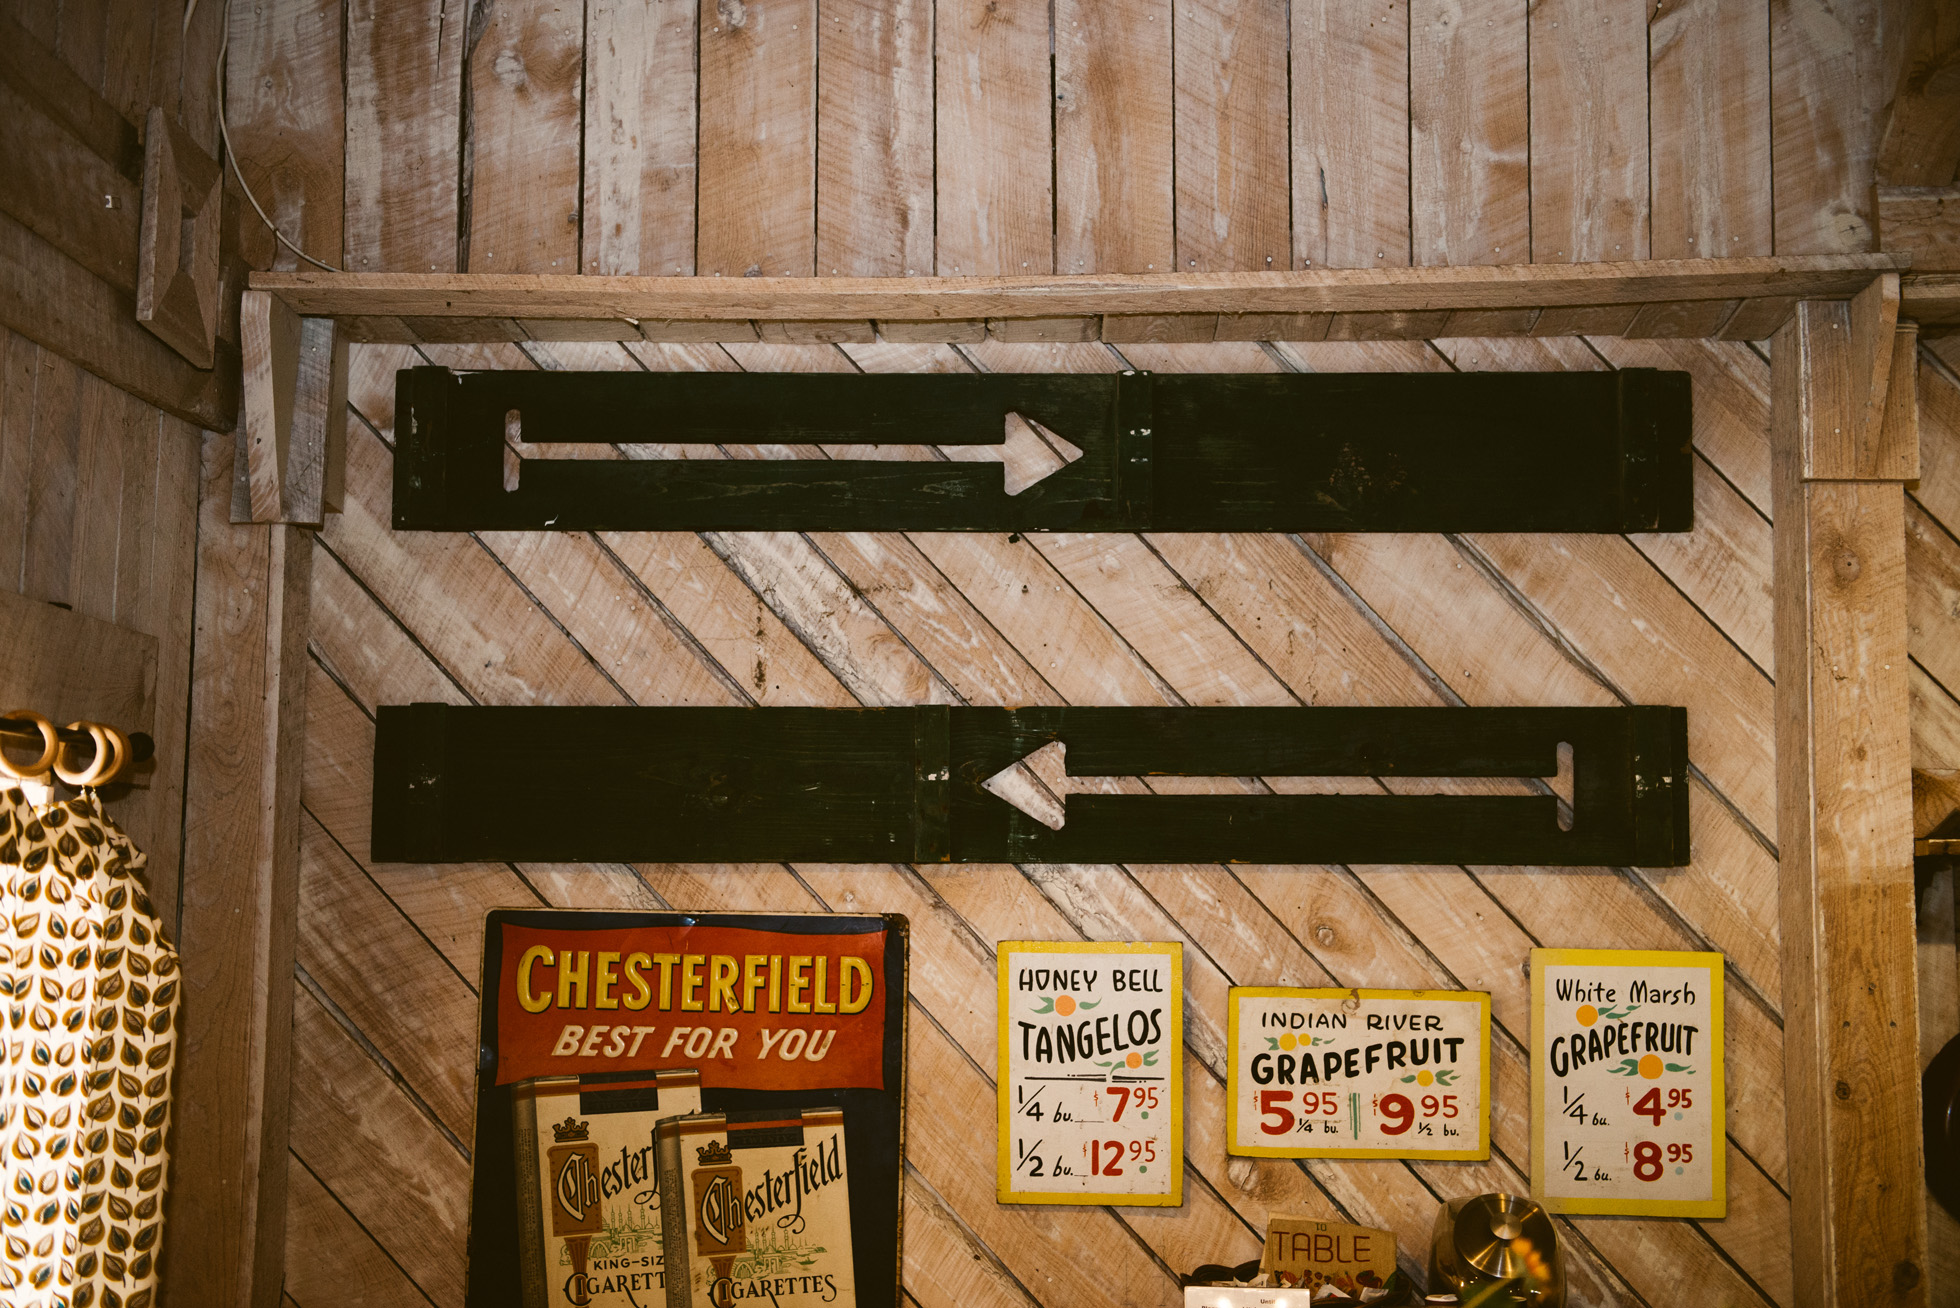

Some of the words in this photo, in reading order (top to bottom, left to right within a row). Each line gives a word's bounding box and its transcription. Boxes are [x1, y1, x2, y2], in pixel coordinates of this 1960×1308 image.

[516, 945, 874, 1014] CHESTERFIELD
[1019, 969, 1097, 992] HONEY
[1112, 969, 1163, 992] BELL
[1556, 978, 1616, 1002] White
[1630, 980, 1696, 1006] Marsh
[1018, 1008, 1162, 1063] TANGELOS
[1262, 1013, 1346, 1029] INDIAN
[1367, 1014, 1443, 1031] RIVER
[551, 1025, 656, 1058] BEST
[660, 1026, 739, 1060] FOR
[757, 1028, 836, 1061] YOU
[1251, 1037, 1464, 1085] GRAPEFRUIT
[1551, 1022, 1698, 1077] GRAPEFRUIT
[557, 1127, 661, 1222] Chesterf
[701, 1133, 843, 1245] Chesterfield
[1315, 1223, 1327, 1231] TO
[594, 1255, 664, 1271] KING-SIZ
[1272, 1231, 1370, 1263] TABLE
[562, 1271, 666, 1308] CIGARETT
[707, 1274, 837, 1308] CIGARETTES
